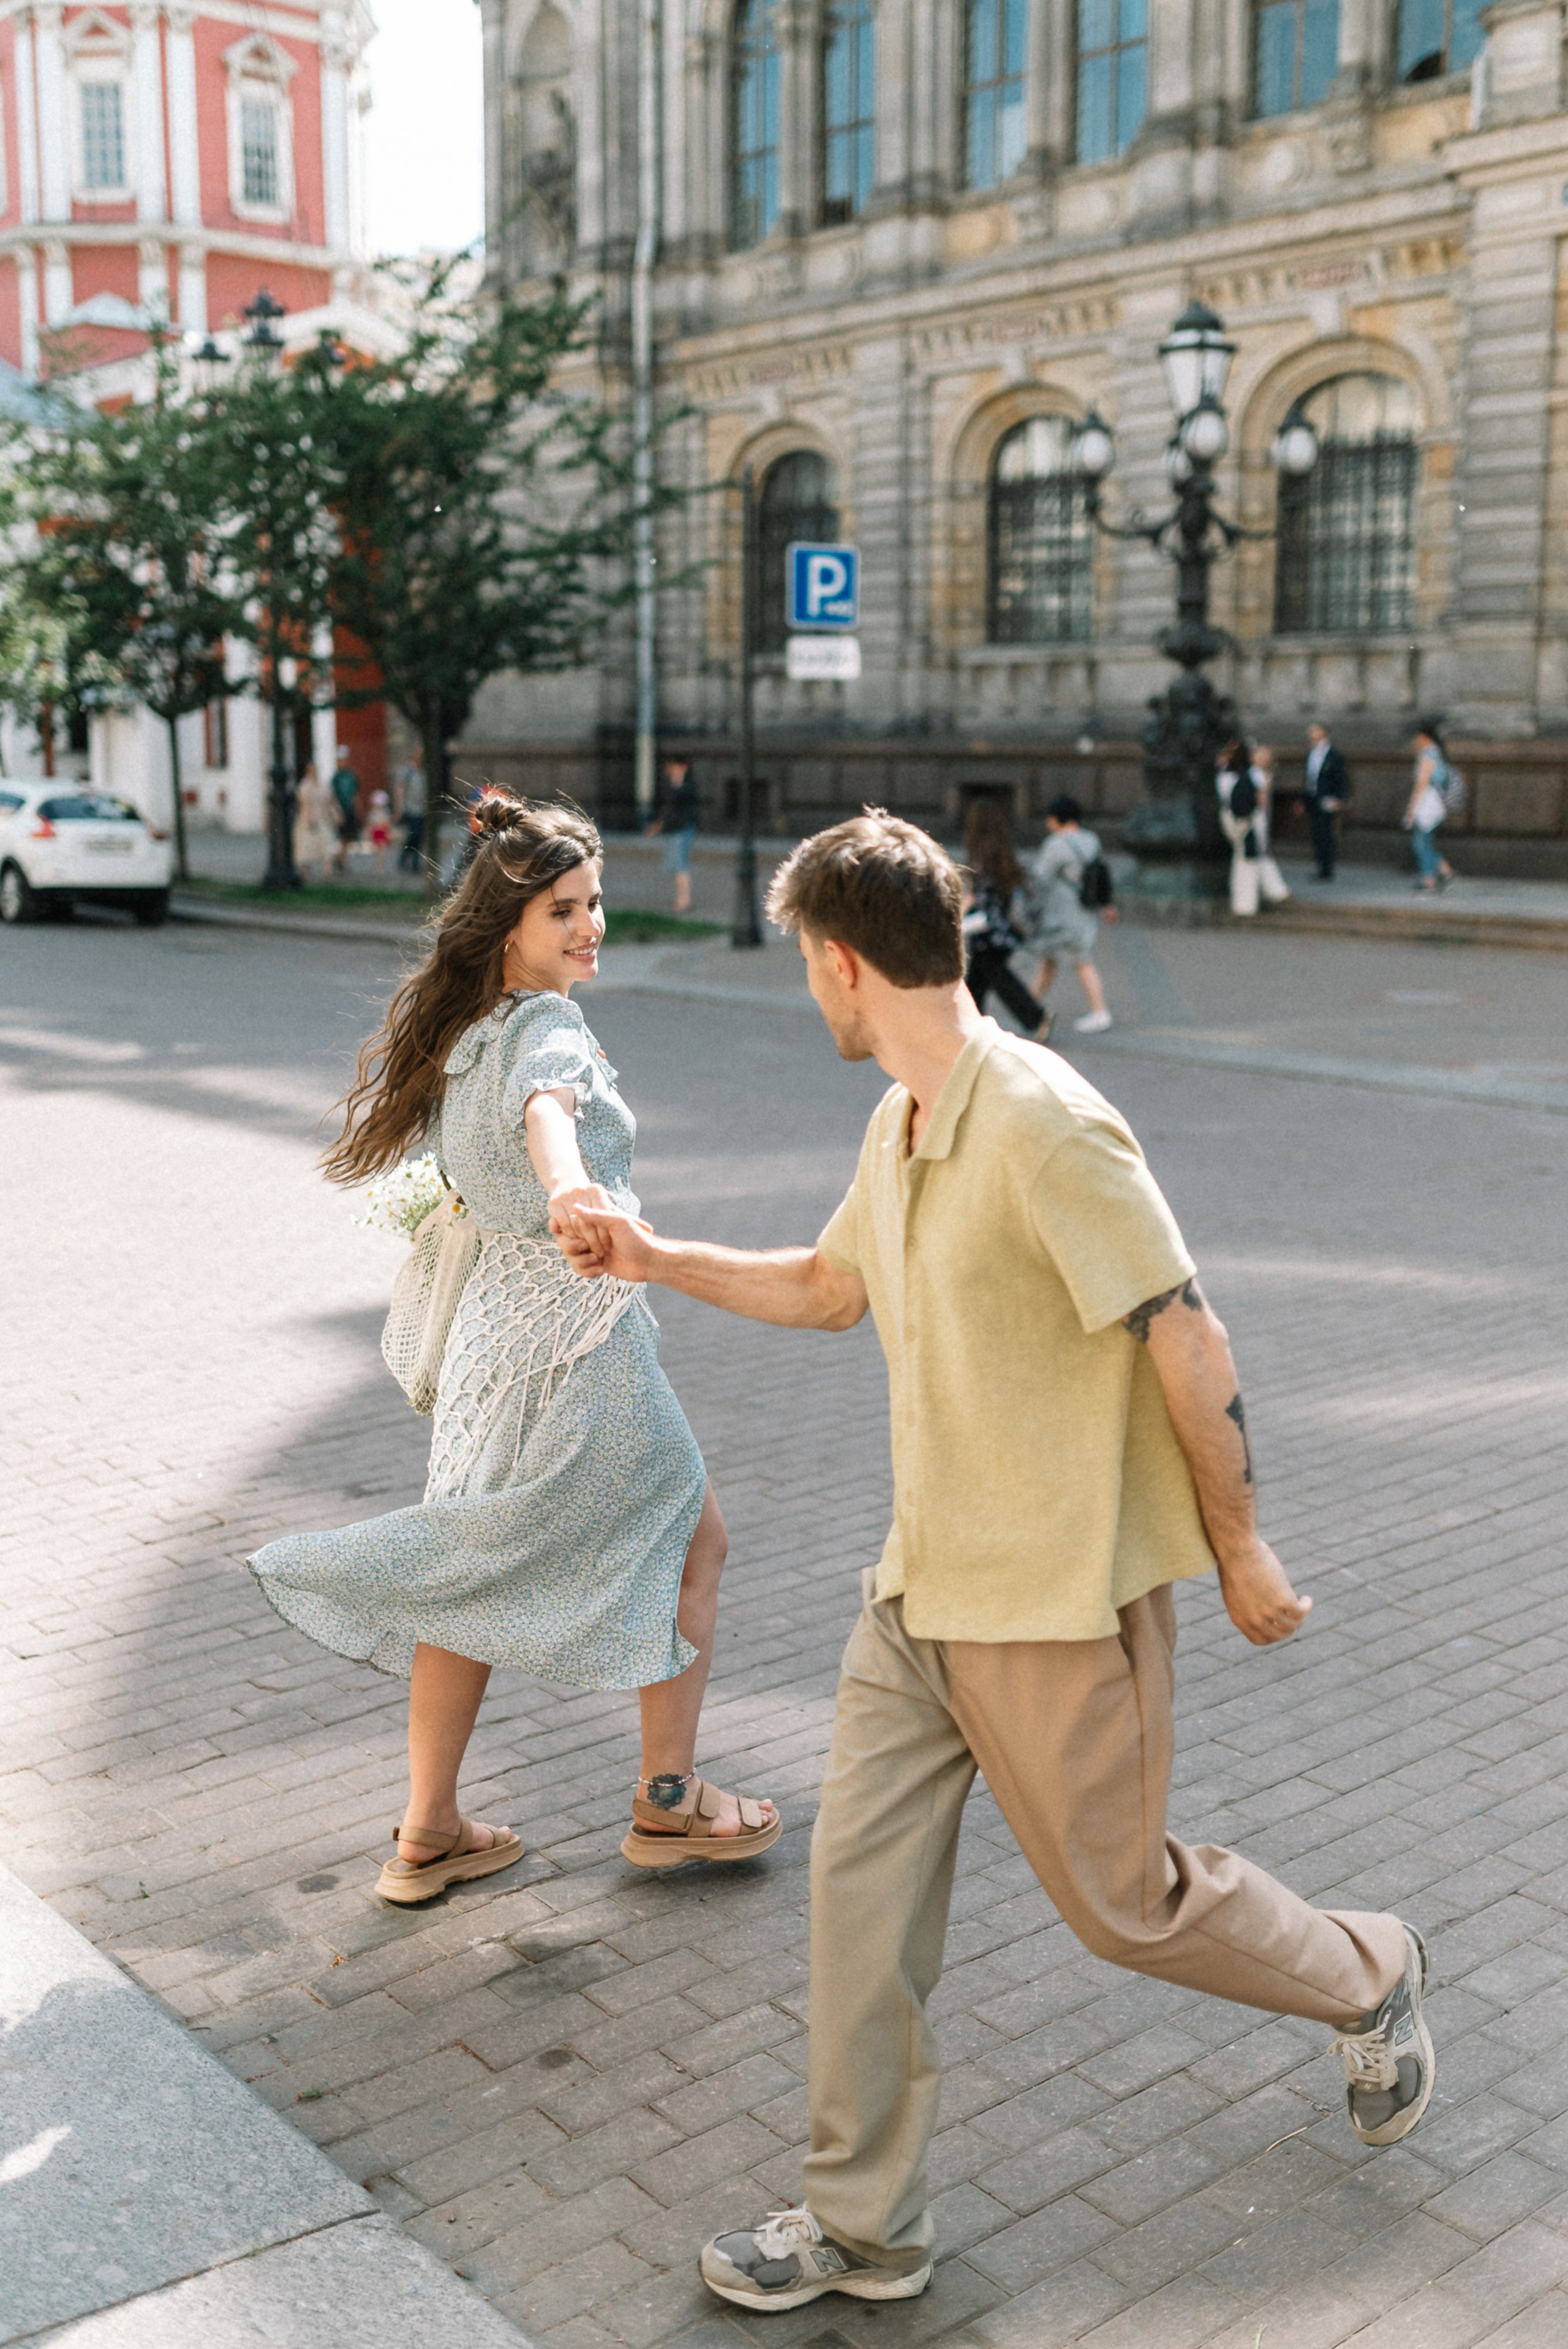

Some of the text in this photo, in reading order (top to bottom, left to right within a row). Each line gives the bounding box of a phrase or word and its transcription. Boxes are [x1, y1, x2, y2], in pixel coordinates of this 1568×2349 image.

[807, 554, 847, 617] P
[1394, 2011, 1414, 2047] N
[809, 2249, 845, 2273] N
